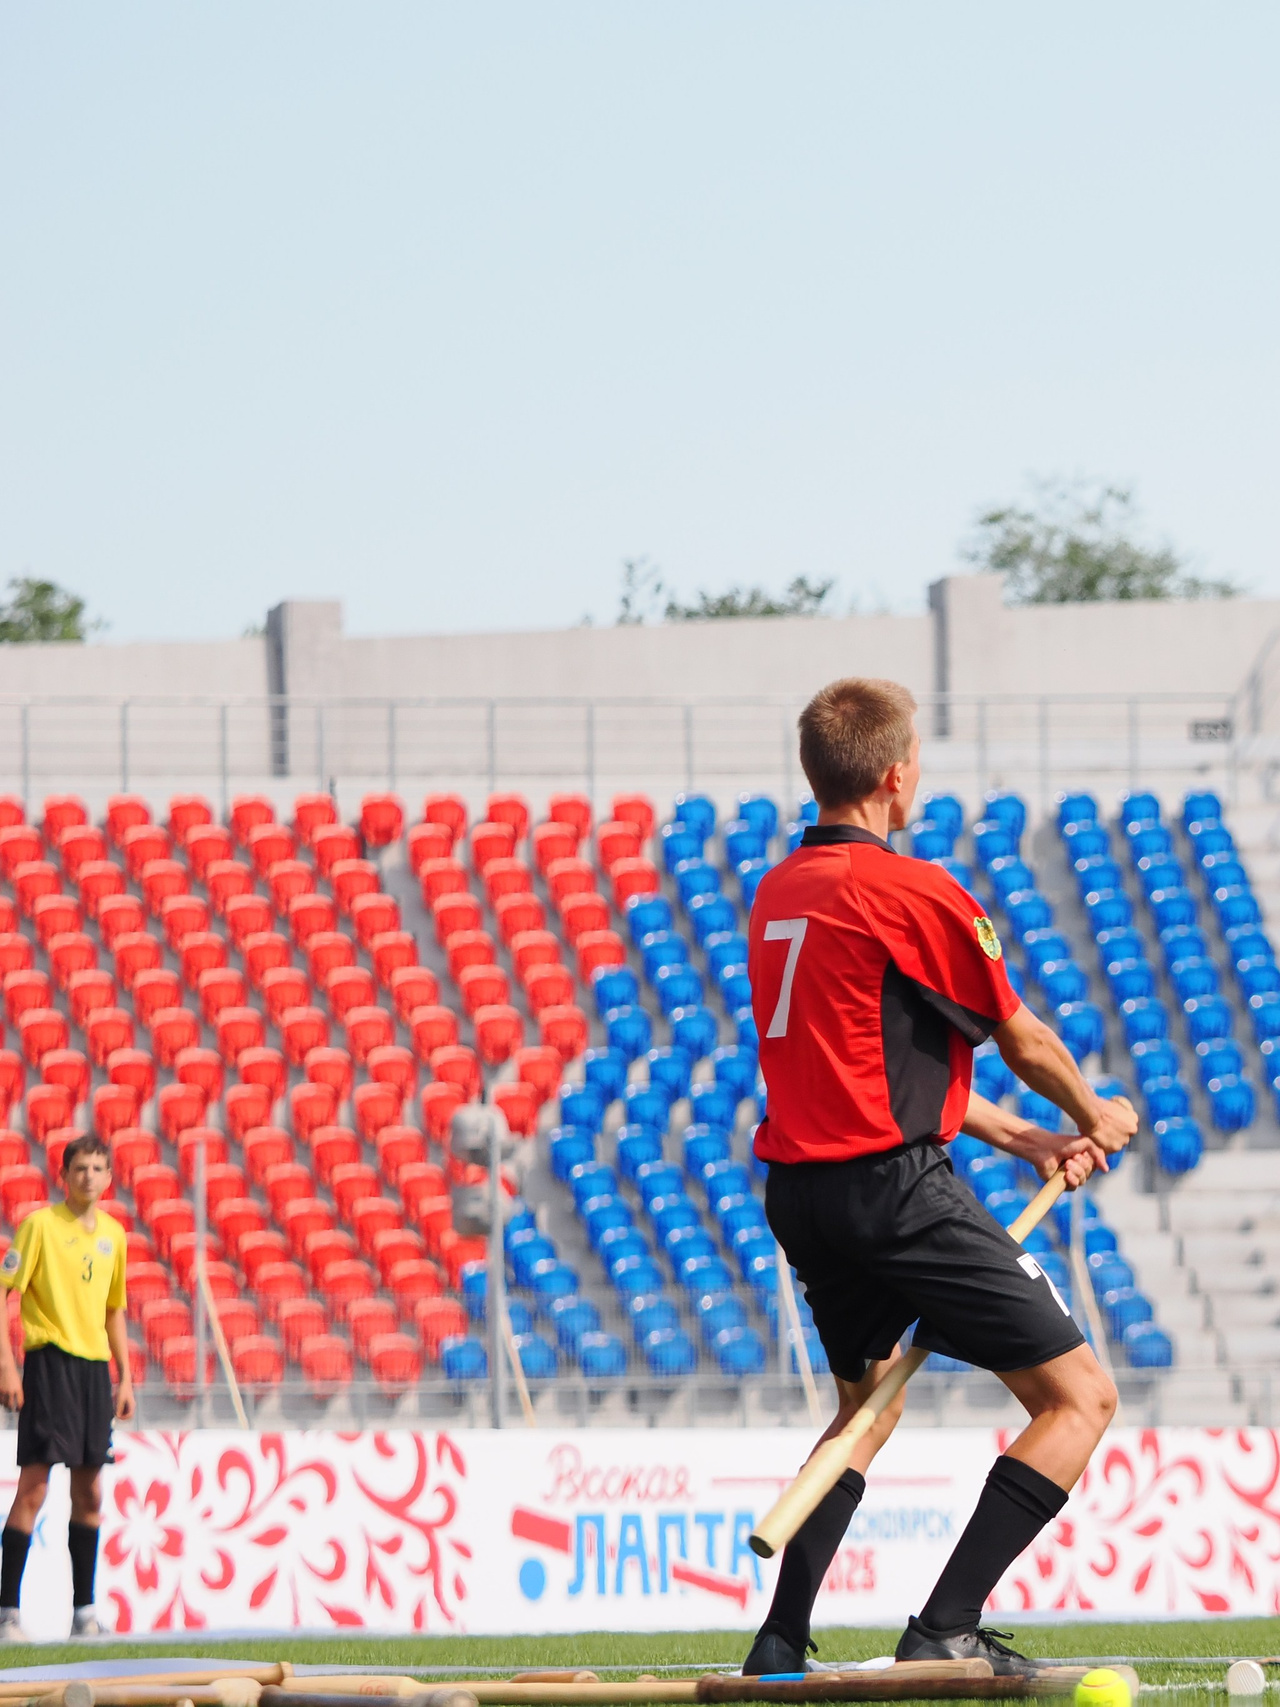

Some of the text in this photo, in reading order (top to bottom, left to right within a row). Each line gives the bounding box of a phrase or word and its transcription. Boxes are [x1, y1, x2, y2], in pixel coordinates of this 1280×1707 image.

[763, 917, 808, 1038] 7
[82, 1254, 93, 1283] 3
[1016, 1253, 1070, 1317] 7
[568, 1513, 763, 1595] ЛАПТА
